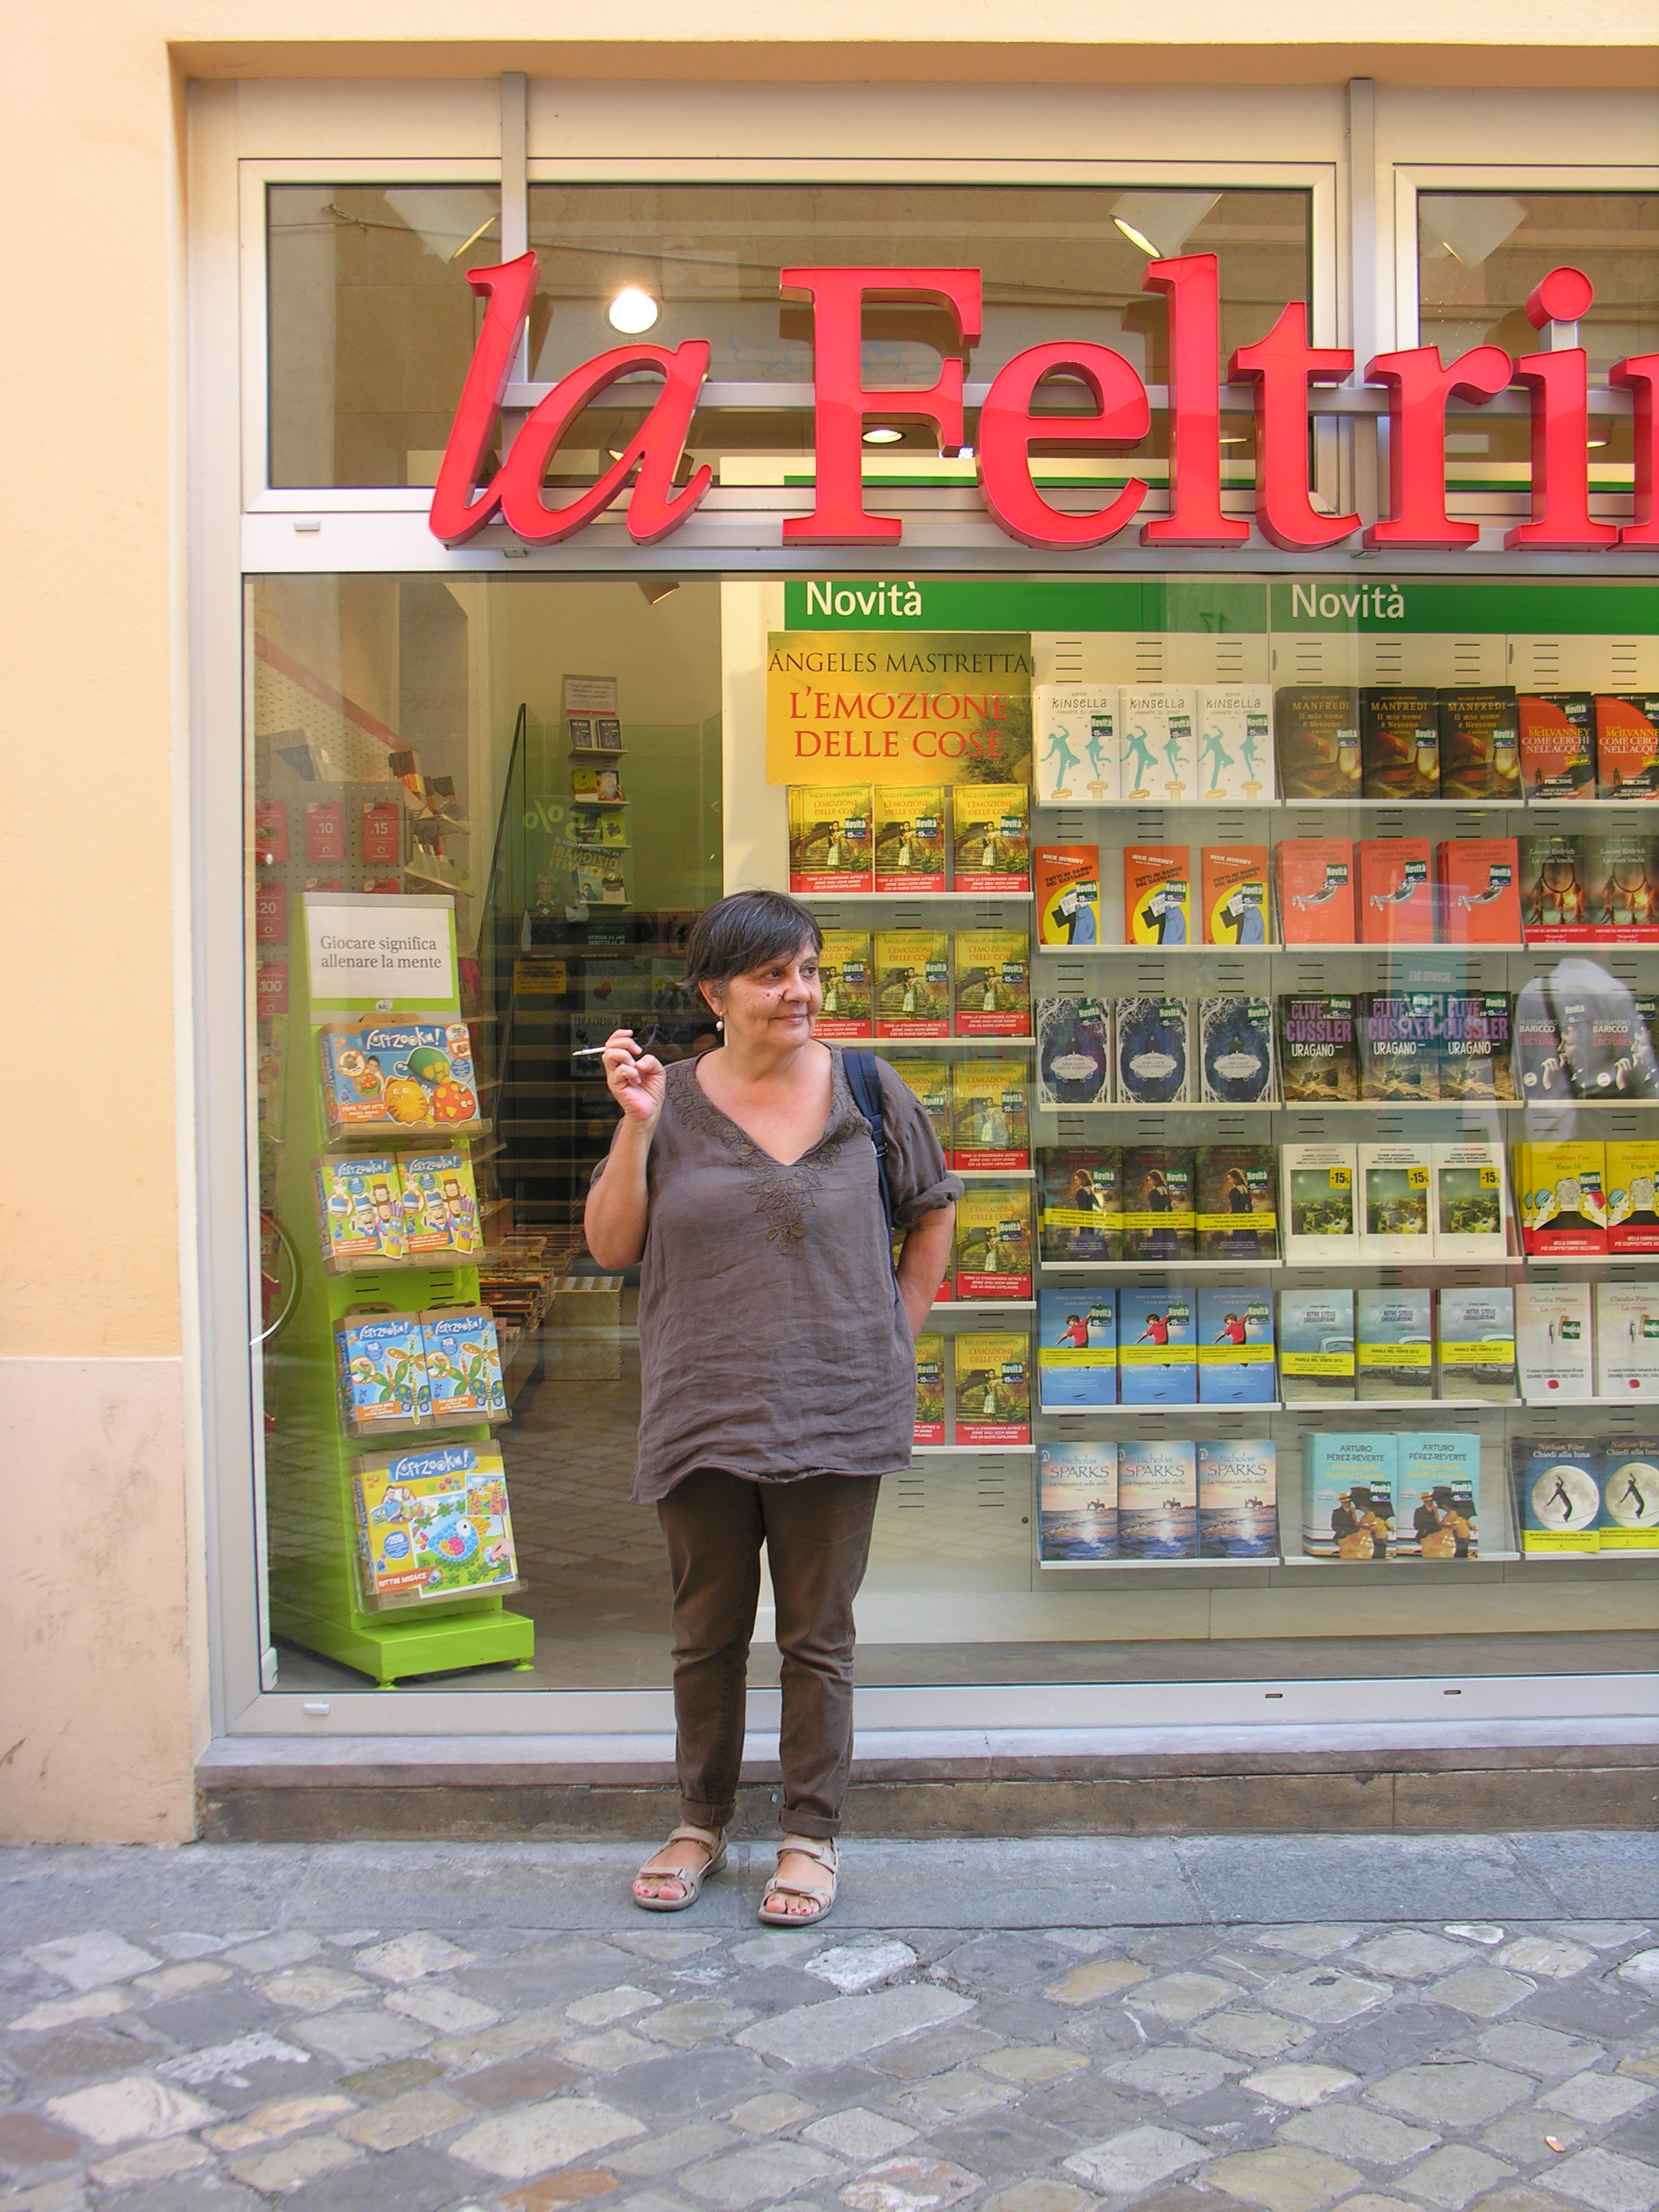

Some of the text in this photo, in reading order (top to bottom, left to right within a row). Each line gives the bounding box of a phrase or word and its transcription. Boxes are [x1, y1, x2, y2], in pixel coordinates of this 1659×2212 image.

[428, 252, 714, 550] la
[806, 581, 922, 615] Novità
[1292, 584, 1404, 618] Novità
[768, 649, 1030, 673] ÁNGELES MASTRETTA
[790, 687, 1008, 720] L'EMOZIONE
[1292, 702, 1349, 710] MANFREDI
[1371, 702, 1427, 711] MANFREDI
[1448, 701, 1506, 711] MANFREDI
[1337, 729, 1357, 739] Novità
[1415, 729, 1435, 739] Novità
[1494, 729, 1514, 739] Novità
[795, 731, 1004, 758] DELLE COSE
[1521, 737, 1589, 745] COME CERCHI
[1599, 737, 1629, 745] COME
[845, 819, 865, 829] Novità
[916, 818, 937, 828] Novità
[1001, 818, 1021, 828] Novità
[1326, 866, 1347, 876] Novità
[1405, 863, 1426, 874] Novità
[1490, 867, 1511, 877] Novità
[1076, 882, 1097, 893] Novità
[1166, 882, 1186, 893] Novità
[1242, 884, 1263, 895] Novità
[321, 936, 437, 954] Giocare significa
[321, 954, 442, 969] allenare la mente
[843, 962, 863, 972] Novità
[926, 963, 947, 973] Novità
[1002, 963, 1023, 974] Novità
[1291, 1004, 1322, 1020] CLIVE
[1373, 1002, 1405, 1017] CLIVE
[1448, 1002, 1479, 1017] CLIVE
[1564, 1004, 1585, 1015] Novità
[1635, 1003, 1655, 1011] Novità
[1286, 1021, 1351, 1042] CUSSLER
[1368, 1019, 1433, 1040] CUSSLER
[1443, 1018, 1509, 1040] CUSSLER
[1292, 1044, 1334, 1057] URAGANO
[1374, 1042, 1416, 1055] URAGANO
[1448, 1042, 1491, 1054] URAGANO
[1093, 1171, 1114, 1181] Novità
[1166, 1172, 1187, 1183] Novità
[1247, 1170, 1267, 1181] Novità
[1091, 1308, 1111, 1318] Novità
[1168, 1307, 1189, 1317] Novità
[1248, 1307, 1269, 1316] Novità
[1049, 1466, 1109, 1479] SPARKS
[1125, 1465, 1185, 1477] SPARKS
[1207, 1464, 1267, 1477] SPARKS
[1370, 1483, 1391, 1493] Novità
[1452, 1483, 1471, 1492] Novità
